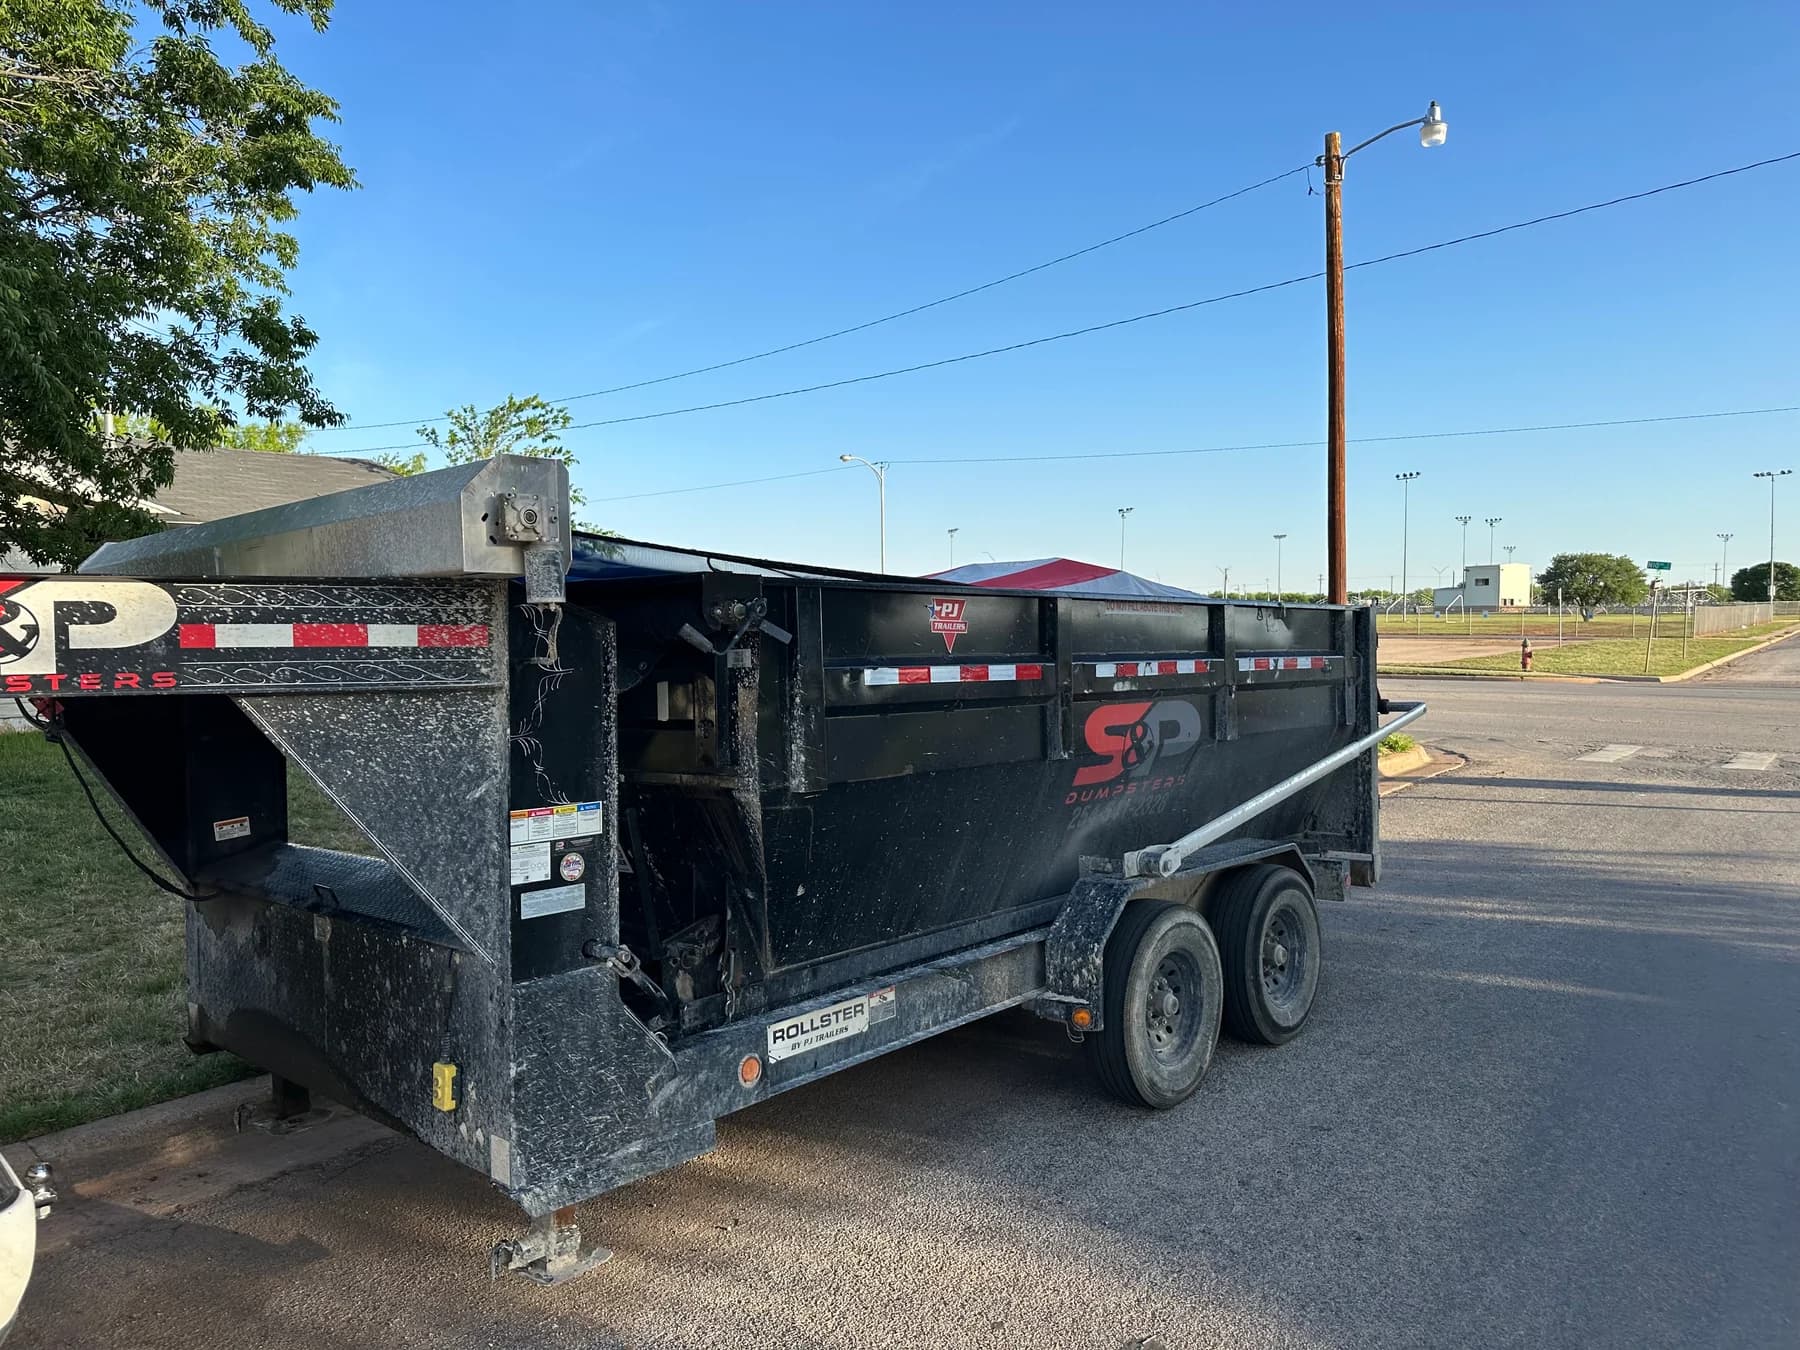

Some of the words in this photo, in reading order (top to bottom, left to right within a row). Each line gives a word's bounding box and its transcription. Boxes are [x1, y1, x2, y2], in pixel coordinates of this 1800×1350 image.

[940, 602, 960, 617] PJ
[934, 622, 966, 631] TRAILERS
[1072, 700, 1202, 786] S&P
[1064, 774, 1186, 805] DUMPSTERS
[773, 1003, 865, 1044] ROLLSTER
[791, 1040, 802, 1051] BY
[803, 1037, 814, 1047] PJ
[815, 1025, 849, 1042] TRAILERS
